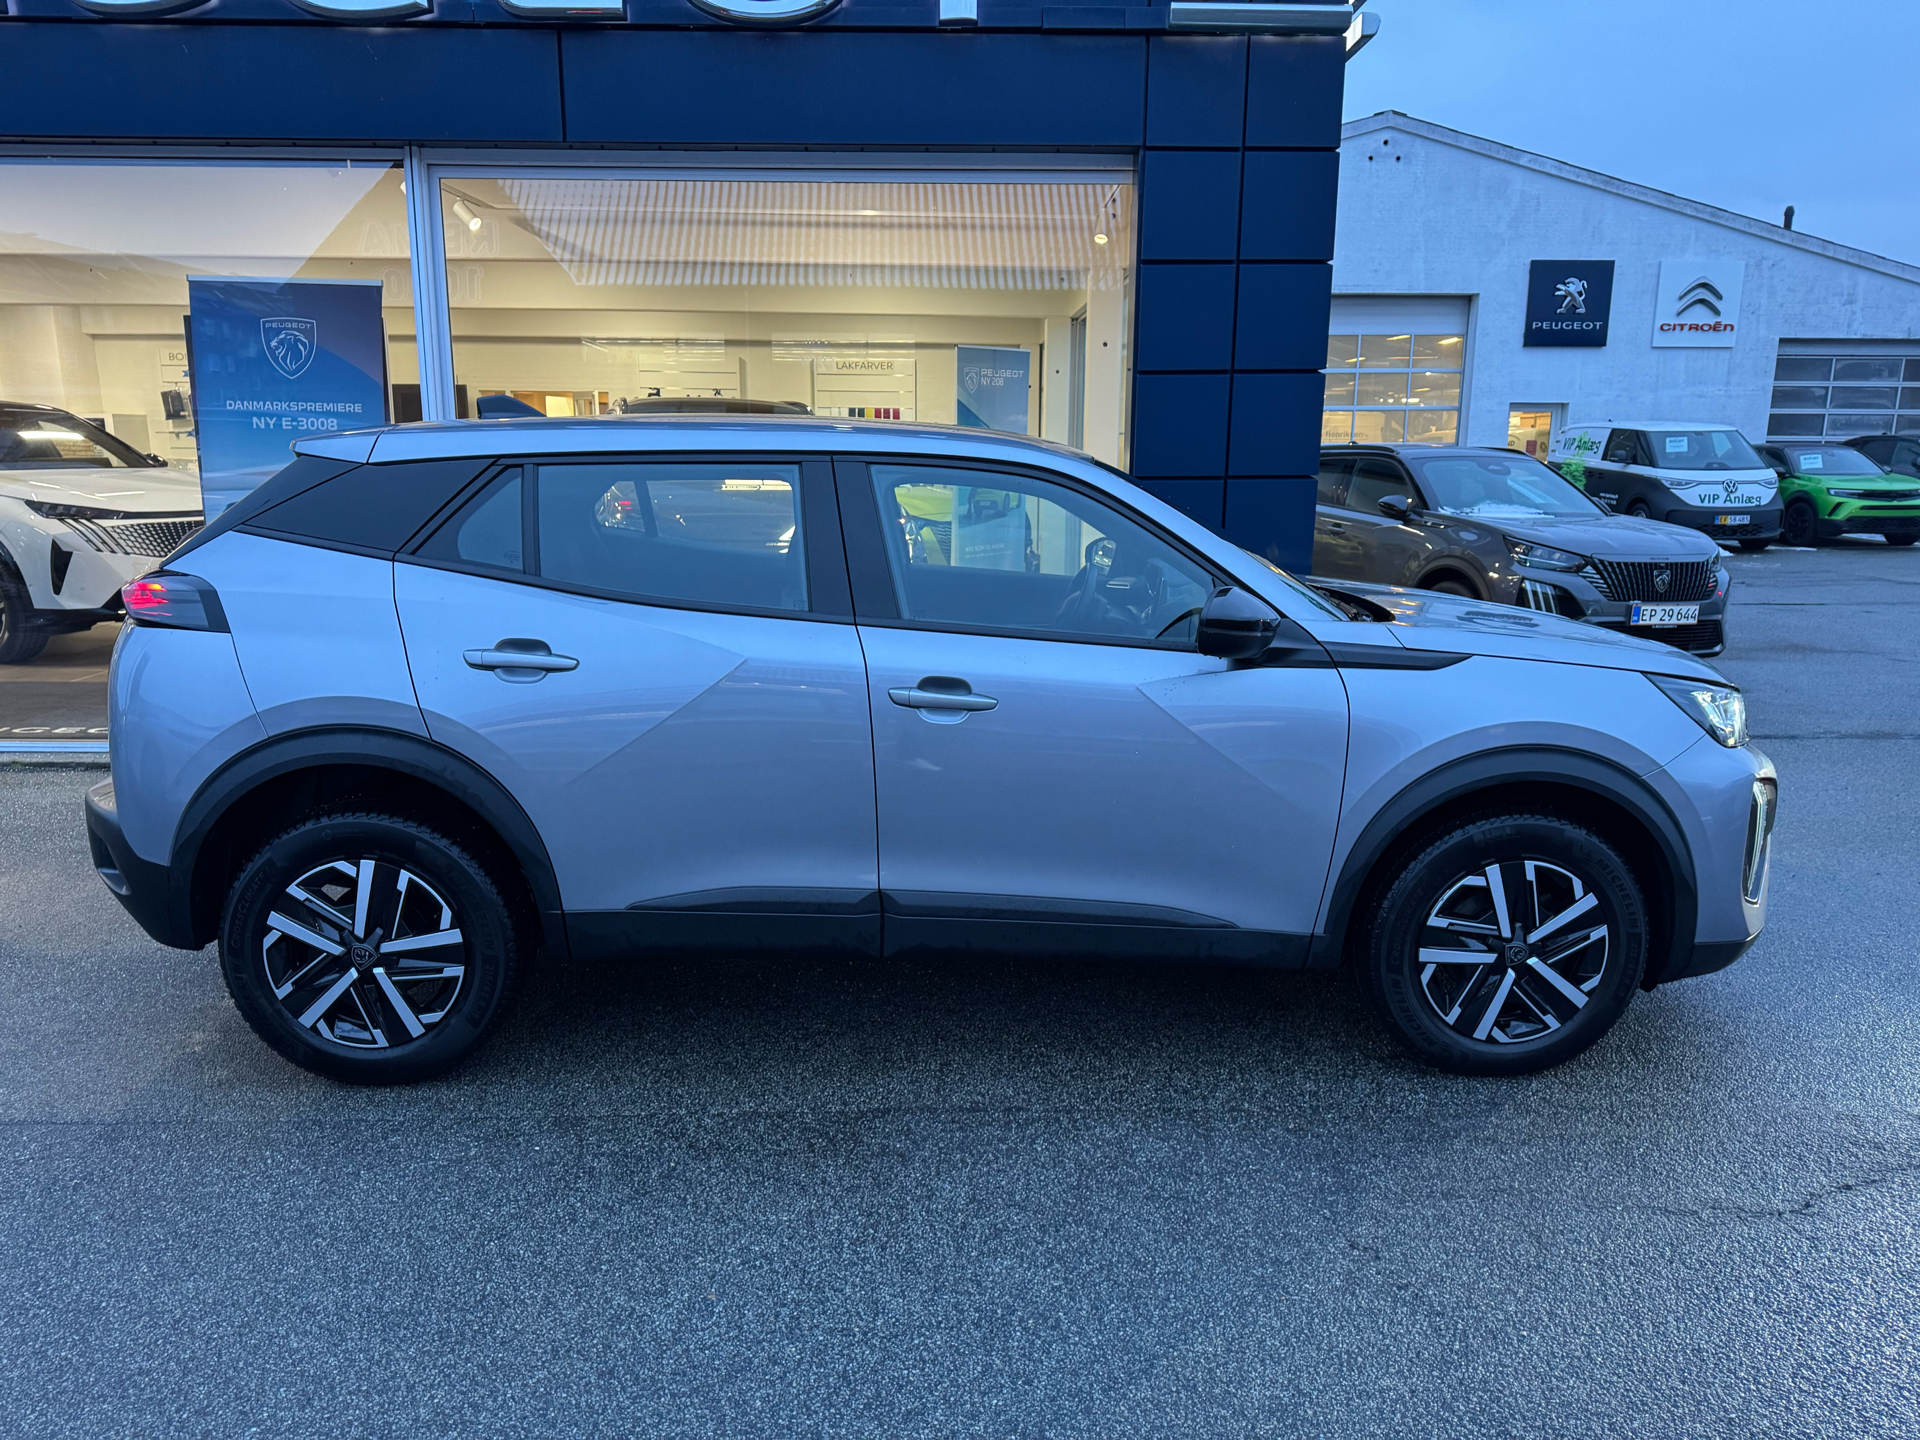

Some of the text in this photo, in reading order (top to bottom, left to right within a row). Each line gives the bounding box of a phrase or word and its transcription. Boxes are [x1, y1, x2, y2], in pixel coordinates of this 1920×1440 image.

[265, 321, 312, 329] PEUGEOT
[1532, 321, 1603, 330] PEUGEOT
[168, 352, 187, 361] BO
[836, 361, 894, 371] LAKFARVER
[981, 368, 1024, 378] PEUGEOT
[981, 377, 991, 386] NY
[226, 400, 362, 413] DANMARKSPREMIERE
[252, 416, 338, 431] NY E-3008
[1563, 437, 1576, 450] VIP
[1698, 493, 1762, 507] VIP Anlæg
[1641, 608, 1698, 622] EP 29 644
[1594, 857, 1640, 929] MICHELIN
[1389, 975, 1439, 1049] MICHELIN
